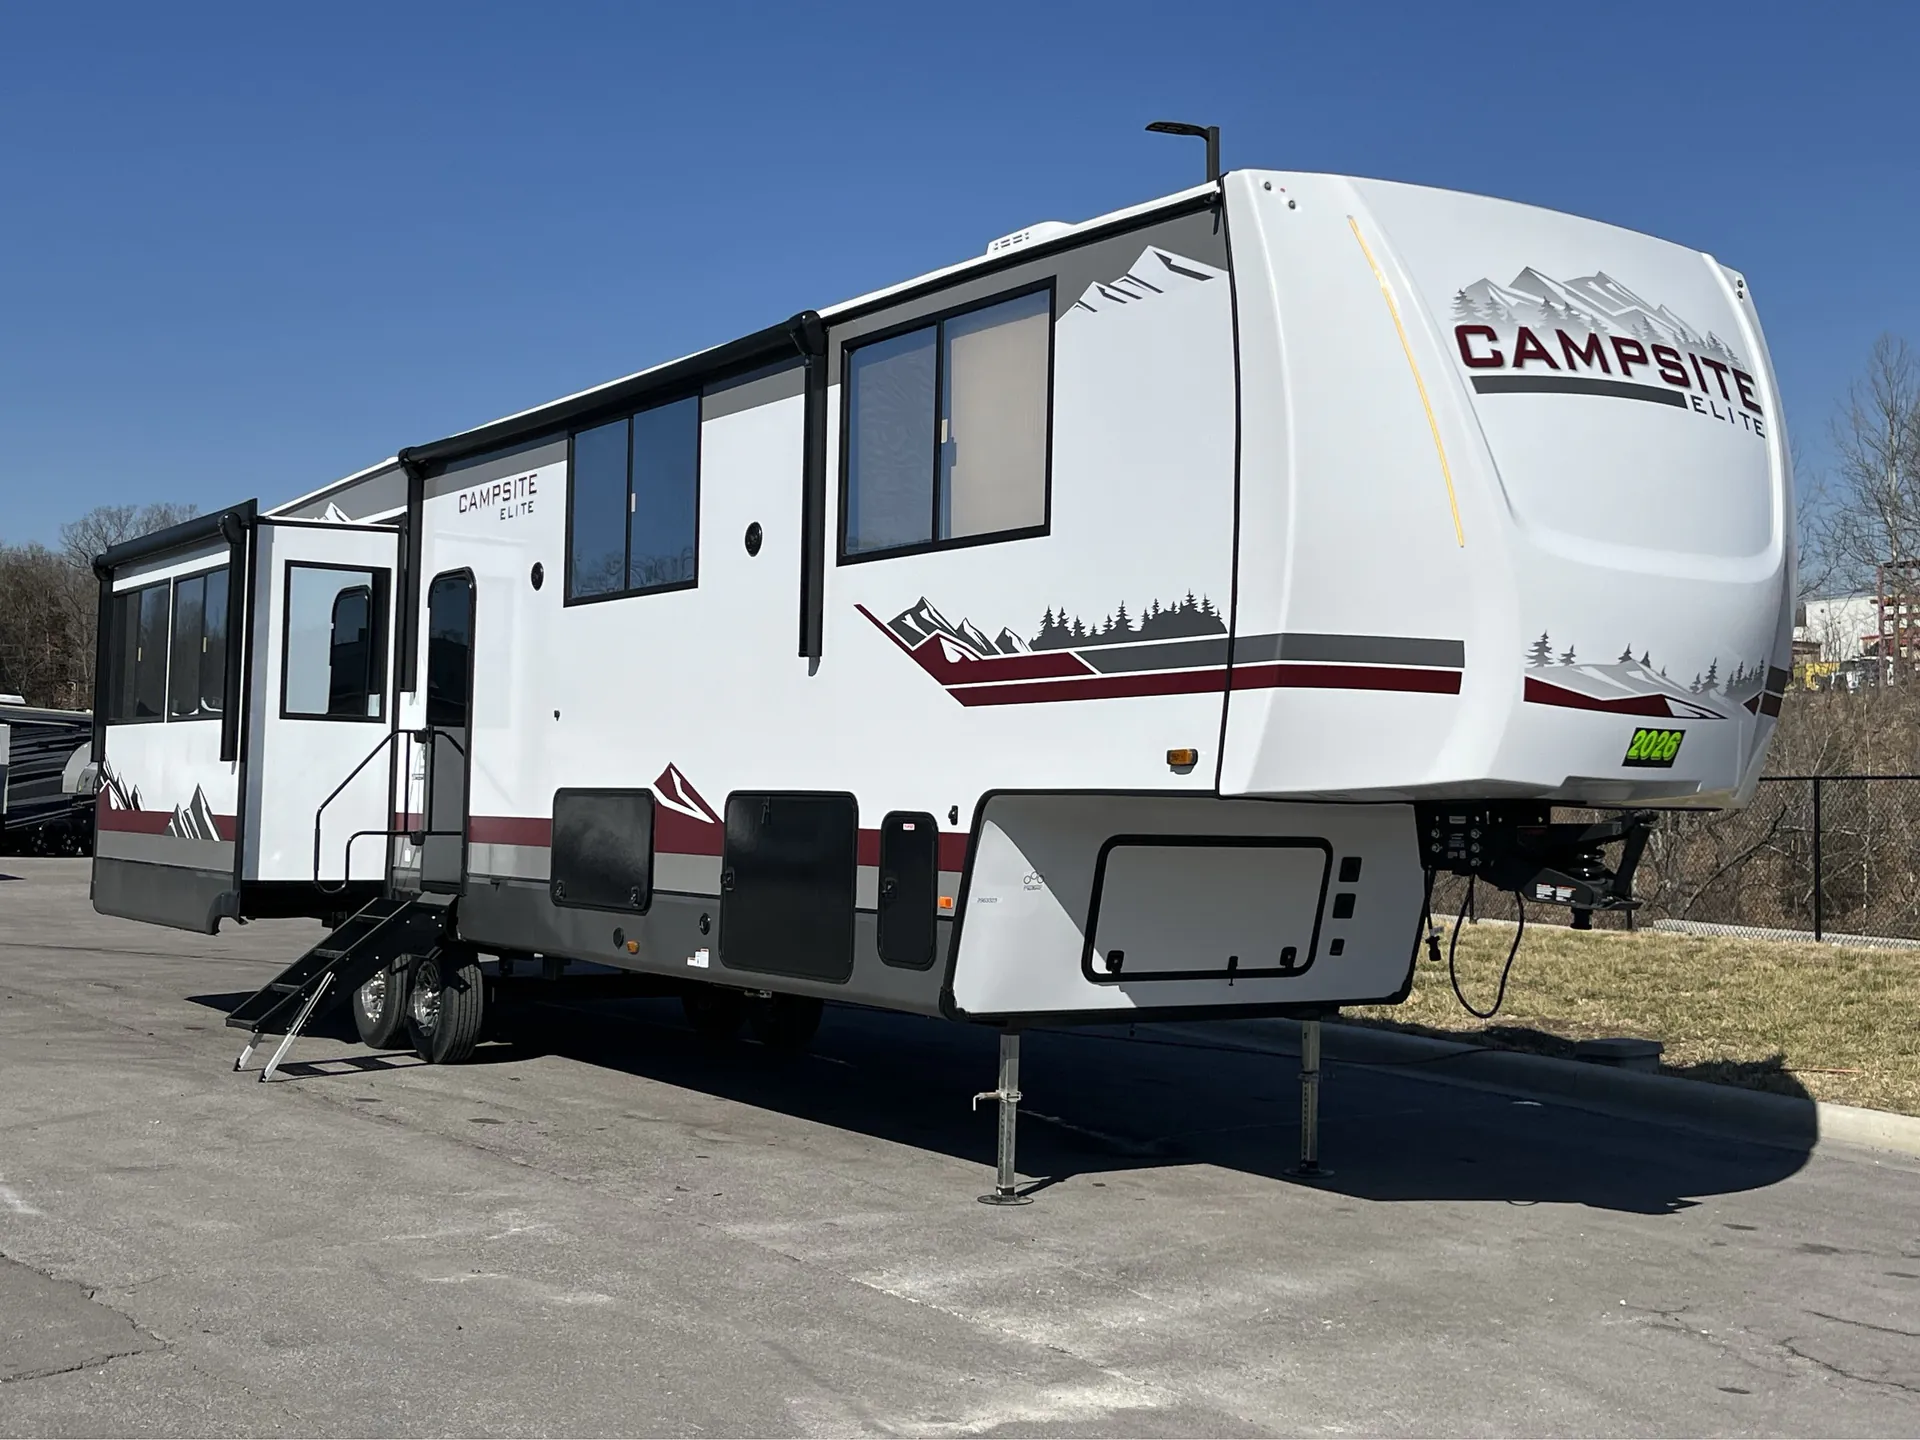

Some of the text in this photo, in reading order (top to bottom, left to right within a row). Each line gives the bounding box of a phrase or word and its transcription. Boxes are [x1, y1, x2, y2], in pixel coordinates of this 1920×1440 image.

[1454, 325, 1763, 416] CAMPSITE
[1691, 395, 1766, 439] ELITE
[459, 473, 537, 513] CAMPSITE
[500, 501, 534, 520] ELITE
[1627, 729, 1682, 761] 2026
